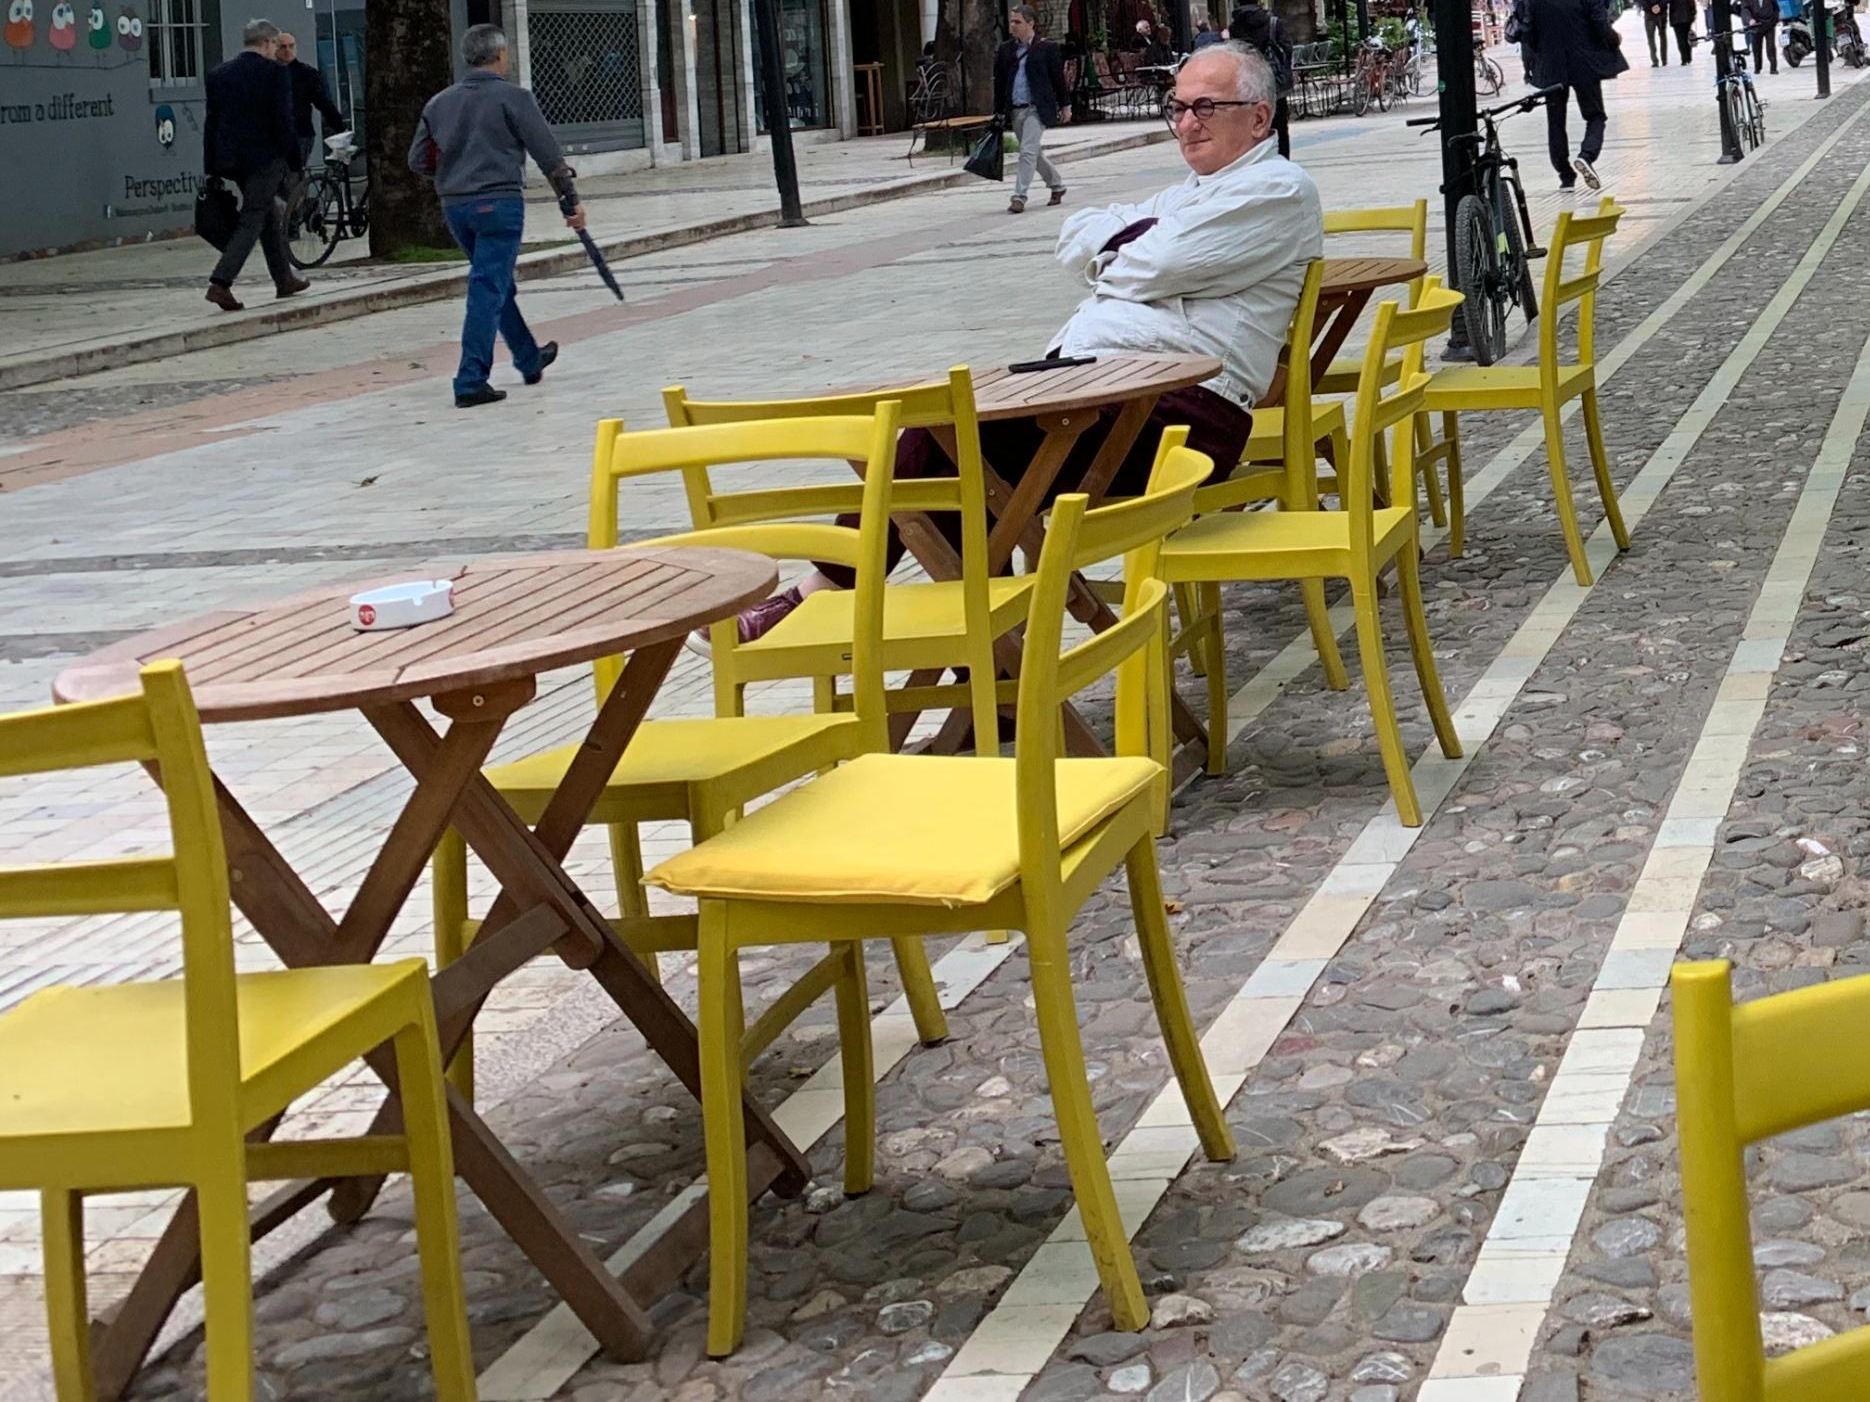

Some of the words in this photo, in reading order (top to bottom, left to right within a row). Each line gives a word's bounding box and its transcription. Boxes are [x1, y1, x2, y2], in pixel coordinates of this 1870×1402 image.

[35, 104, 45, 122] a
[47, 92, 115, 120] different
[124, 172, 206, 200] Perspectiv
